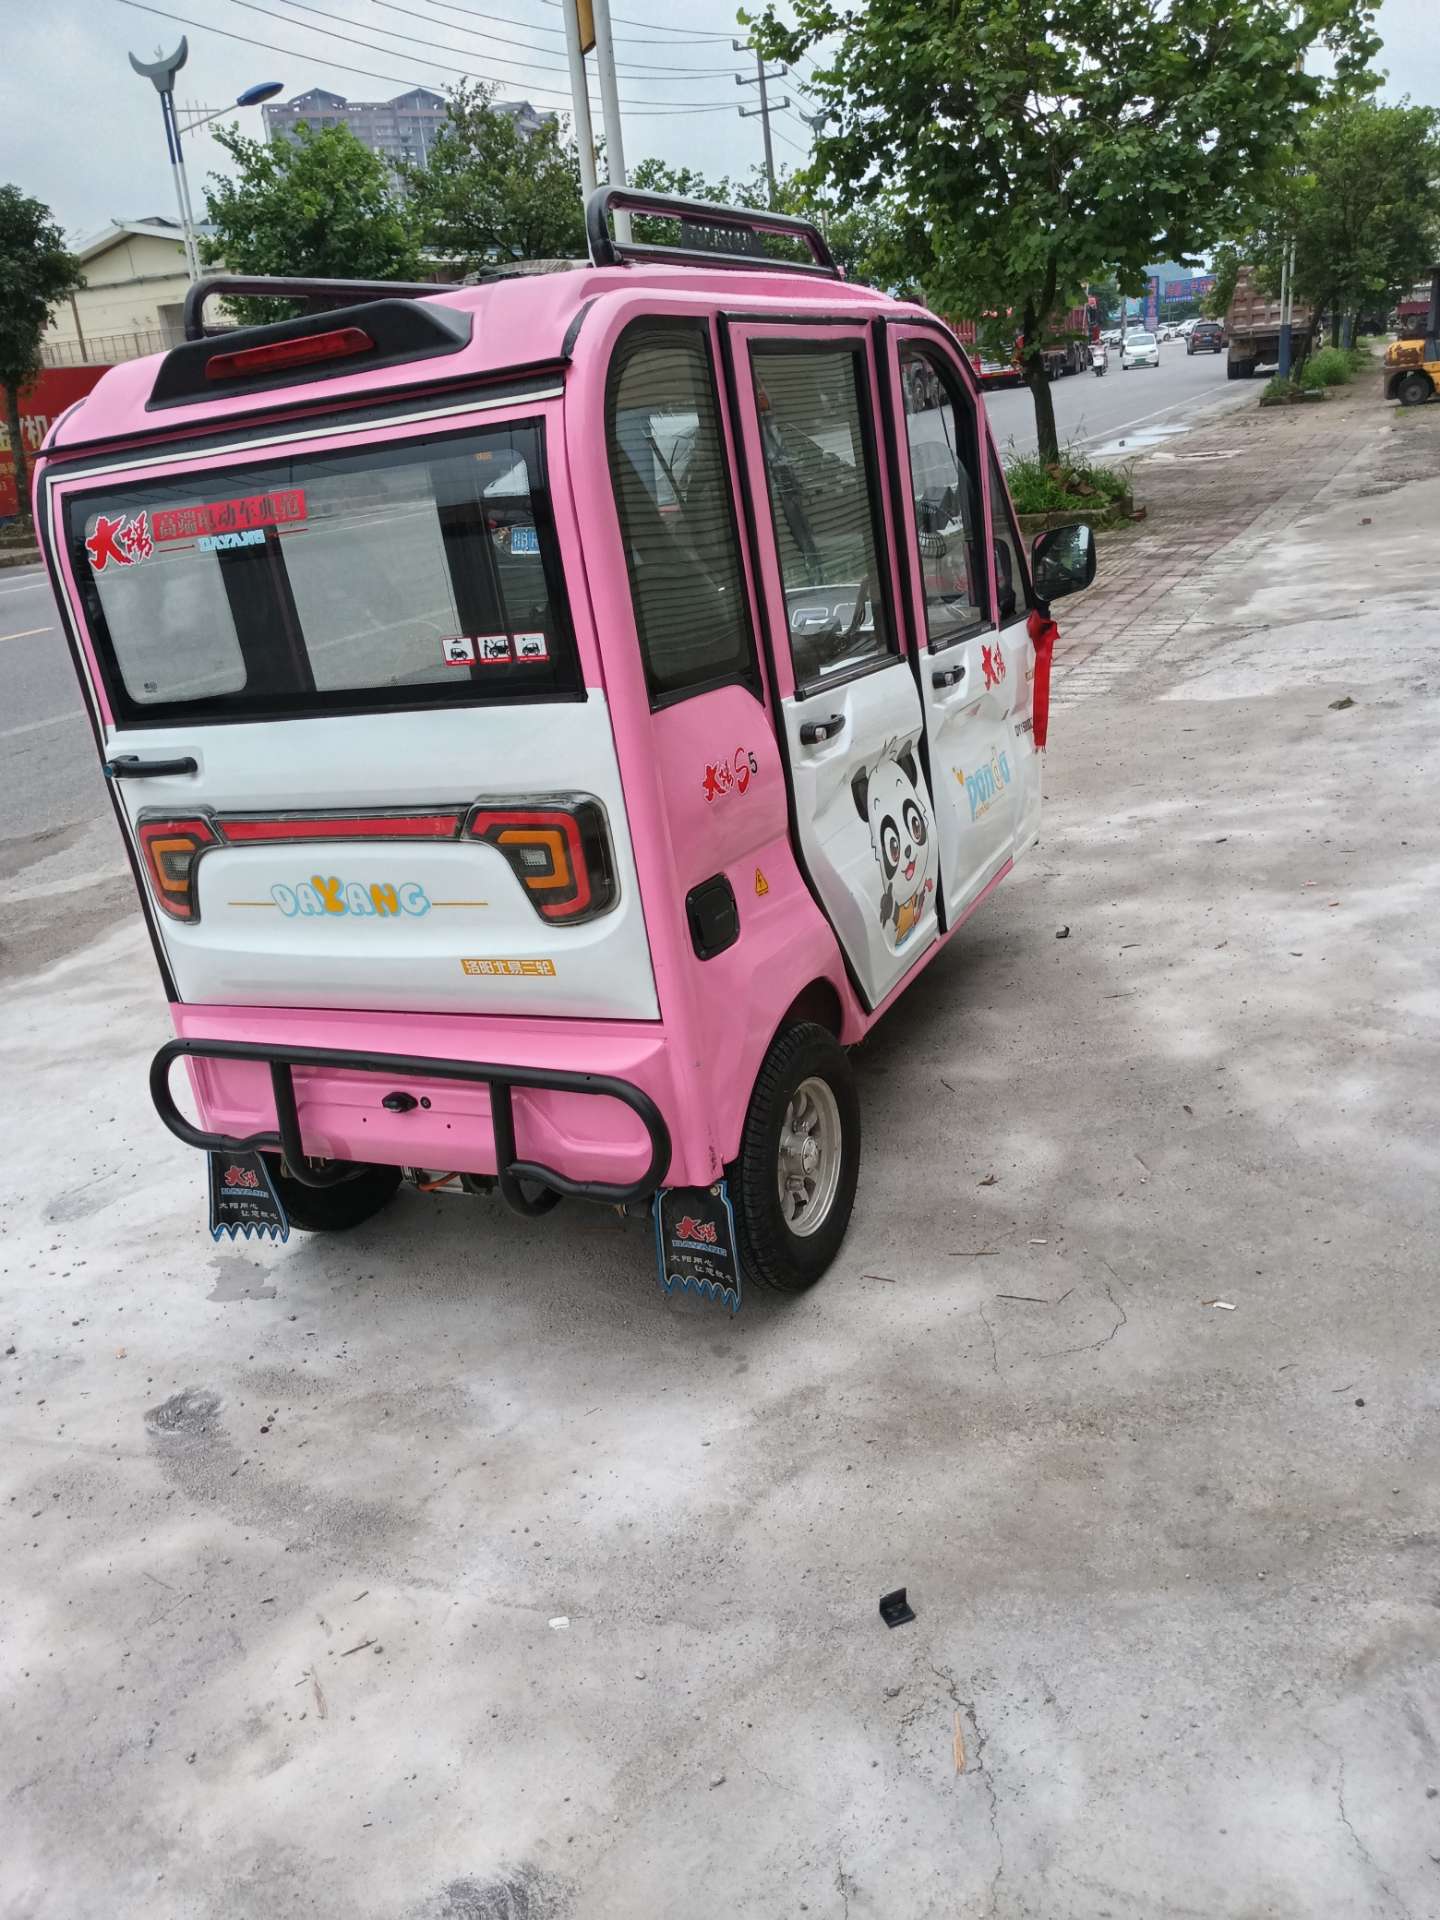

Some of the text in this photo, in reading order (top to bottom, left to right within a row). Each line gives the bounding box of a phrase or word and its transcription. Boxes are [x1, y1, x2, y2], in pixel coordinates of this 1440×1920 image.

[197, 529, 265, 551] DAYANG
[270, 875, 432, 917] DAYANG
[465, 960, 553, 976] 洛阳北易三轮
